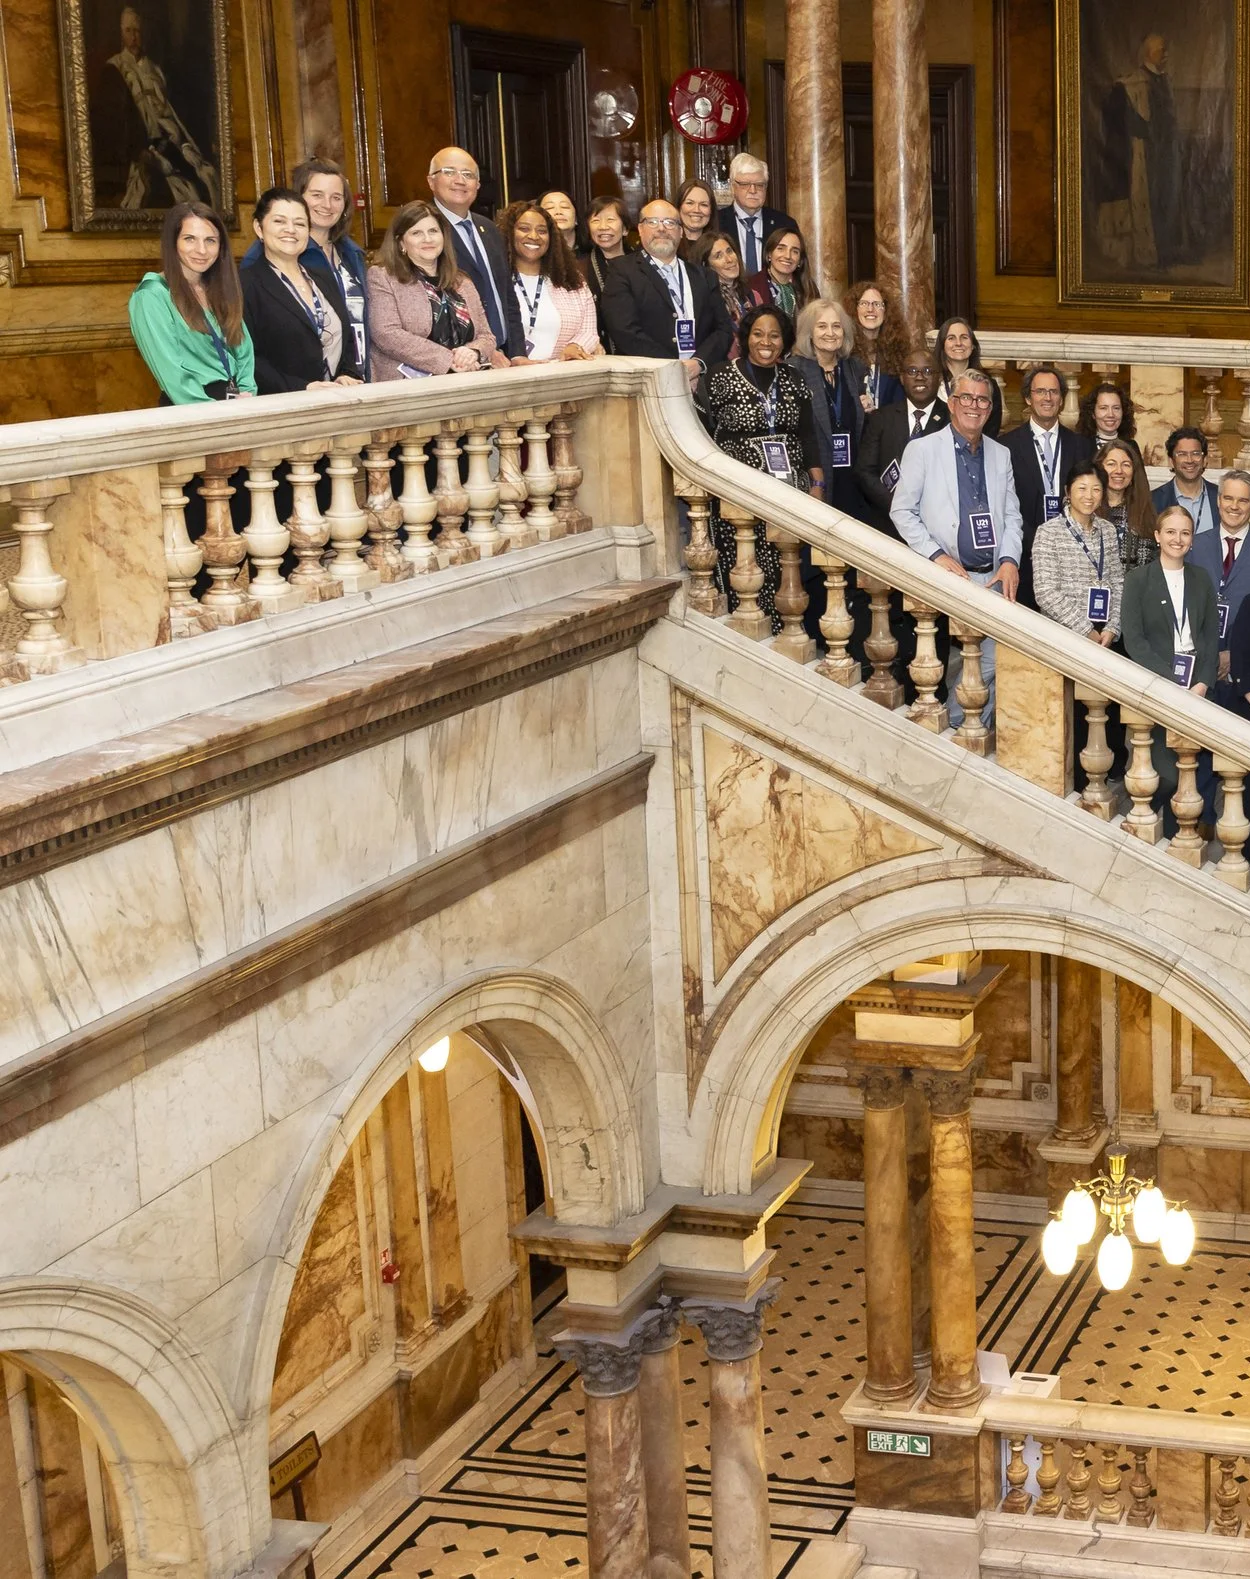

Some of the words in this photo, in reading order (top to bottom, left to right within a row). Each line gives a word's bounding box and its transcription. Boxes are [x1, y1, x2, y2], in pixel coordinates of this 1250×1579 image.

[708, 71, 729, 94] FIRE
[833, 439, 845, 447] U21
[976, 519, 989, 528] U21
[871, 1432, 893, 1443] FIRE
[871, 1441, 893, 1451] EXIT
[277, 1448, 314, 1480] TOILETS
